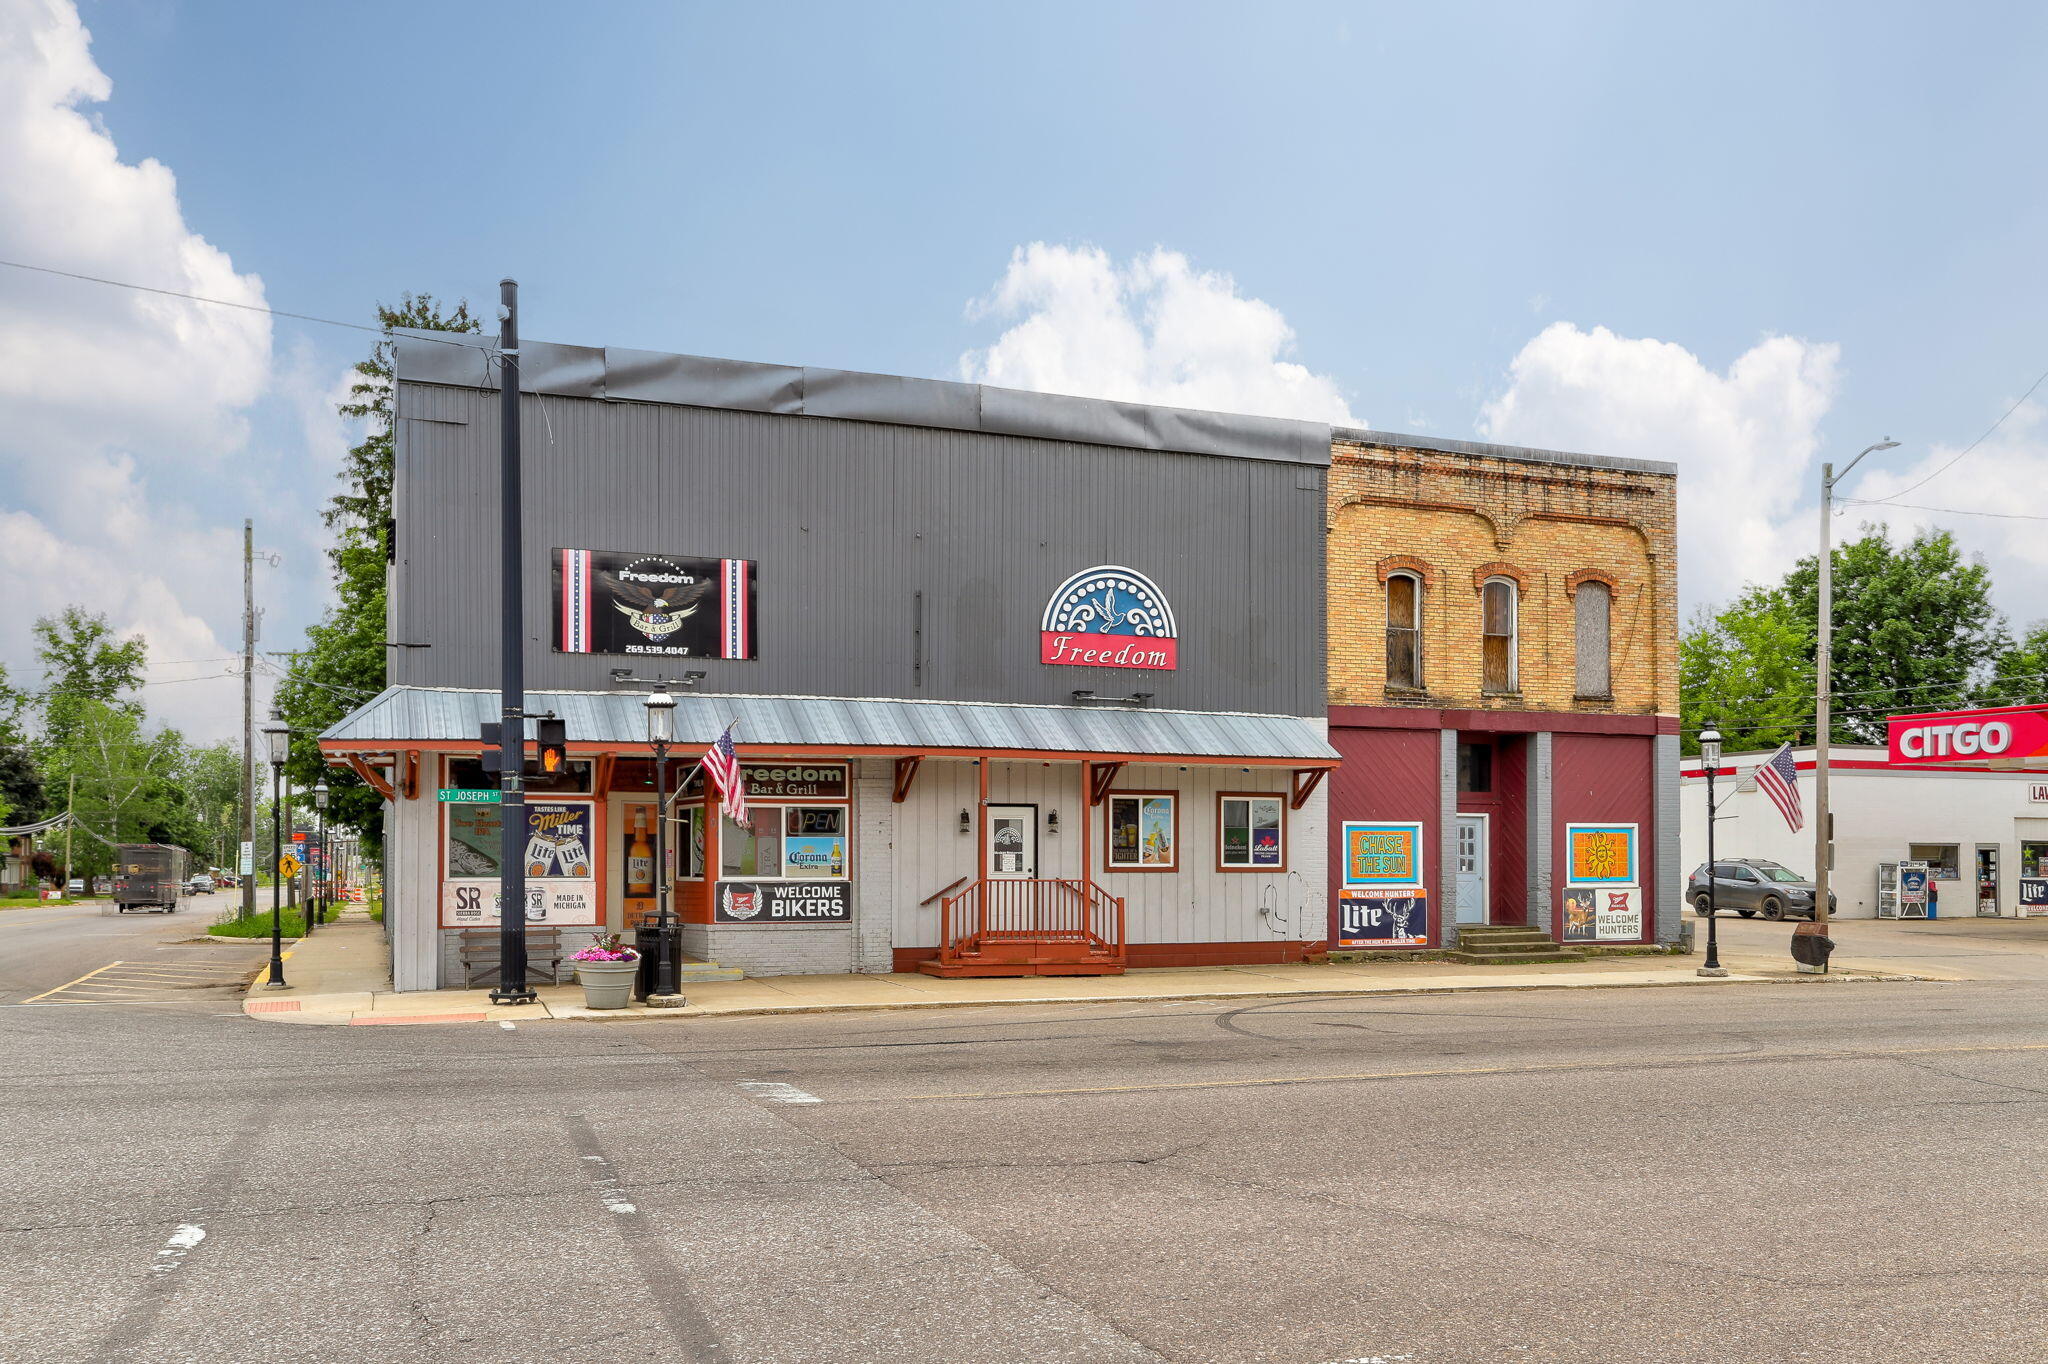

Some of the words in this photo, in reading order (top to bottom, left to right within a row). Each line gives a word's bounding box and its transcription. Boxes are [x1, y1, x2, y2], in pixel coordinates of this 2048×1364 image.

[619, 571, 693, 584] Freedom
[633, 620, 649, 633] Bar
[658, 621, 680, 634] Grill
[625, 645, 688, 655] 269.539.4047
[1050, 636, 1168, 666] Freedom
[1900, 721, 2011, 759] CITGO
[741, 766, 841, 781] reedom
[751, 783, 774, 794] Bar
[775, 783, 784, 794] &
[786, 784, 818, 795] Grill
[440, 791, 451, 800] ST
[455, 791, 489, 801] JOSEPH
[1144, 806, 1170, 816] Corona
[529, 811, 584, 832] Miller
[556, 824, 584, 835] TIME
[531, 842, 555, 860] Lite
[1254, 844, 1278, 852] Labatt
[1360, 835, 1403, 855] CHASE
[561, 842, 584, 864] Lite
[789, 851, 828, 865] Corona
[632, 858, 649, 870] Lite
[799, 862, 819, 870] Extra
[1357, 856, 1381, 873] THE
[1383, 856, 1406, 873] SUN
[456, 887, 482, 909] SR
[774, 886, 841, 898] WELCOME
[1351, 890, 1384, 898] WELCOME
[1384, 889, 1415, 897] HUNTERS
[2021, 882, 2045, 902] Lite
[531, 893, 543, 906] SR
[553, 902, 586, 910] MICHIGAN
[771, 899, 843, 917] BIKERS
[1341, 904, 1382, 934] Lite
[1598, 914, 1640, 924] WELCOME
[1599, 924, 1639, 934] HUNTERS
